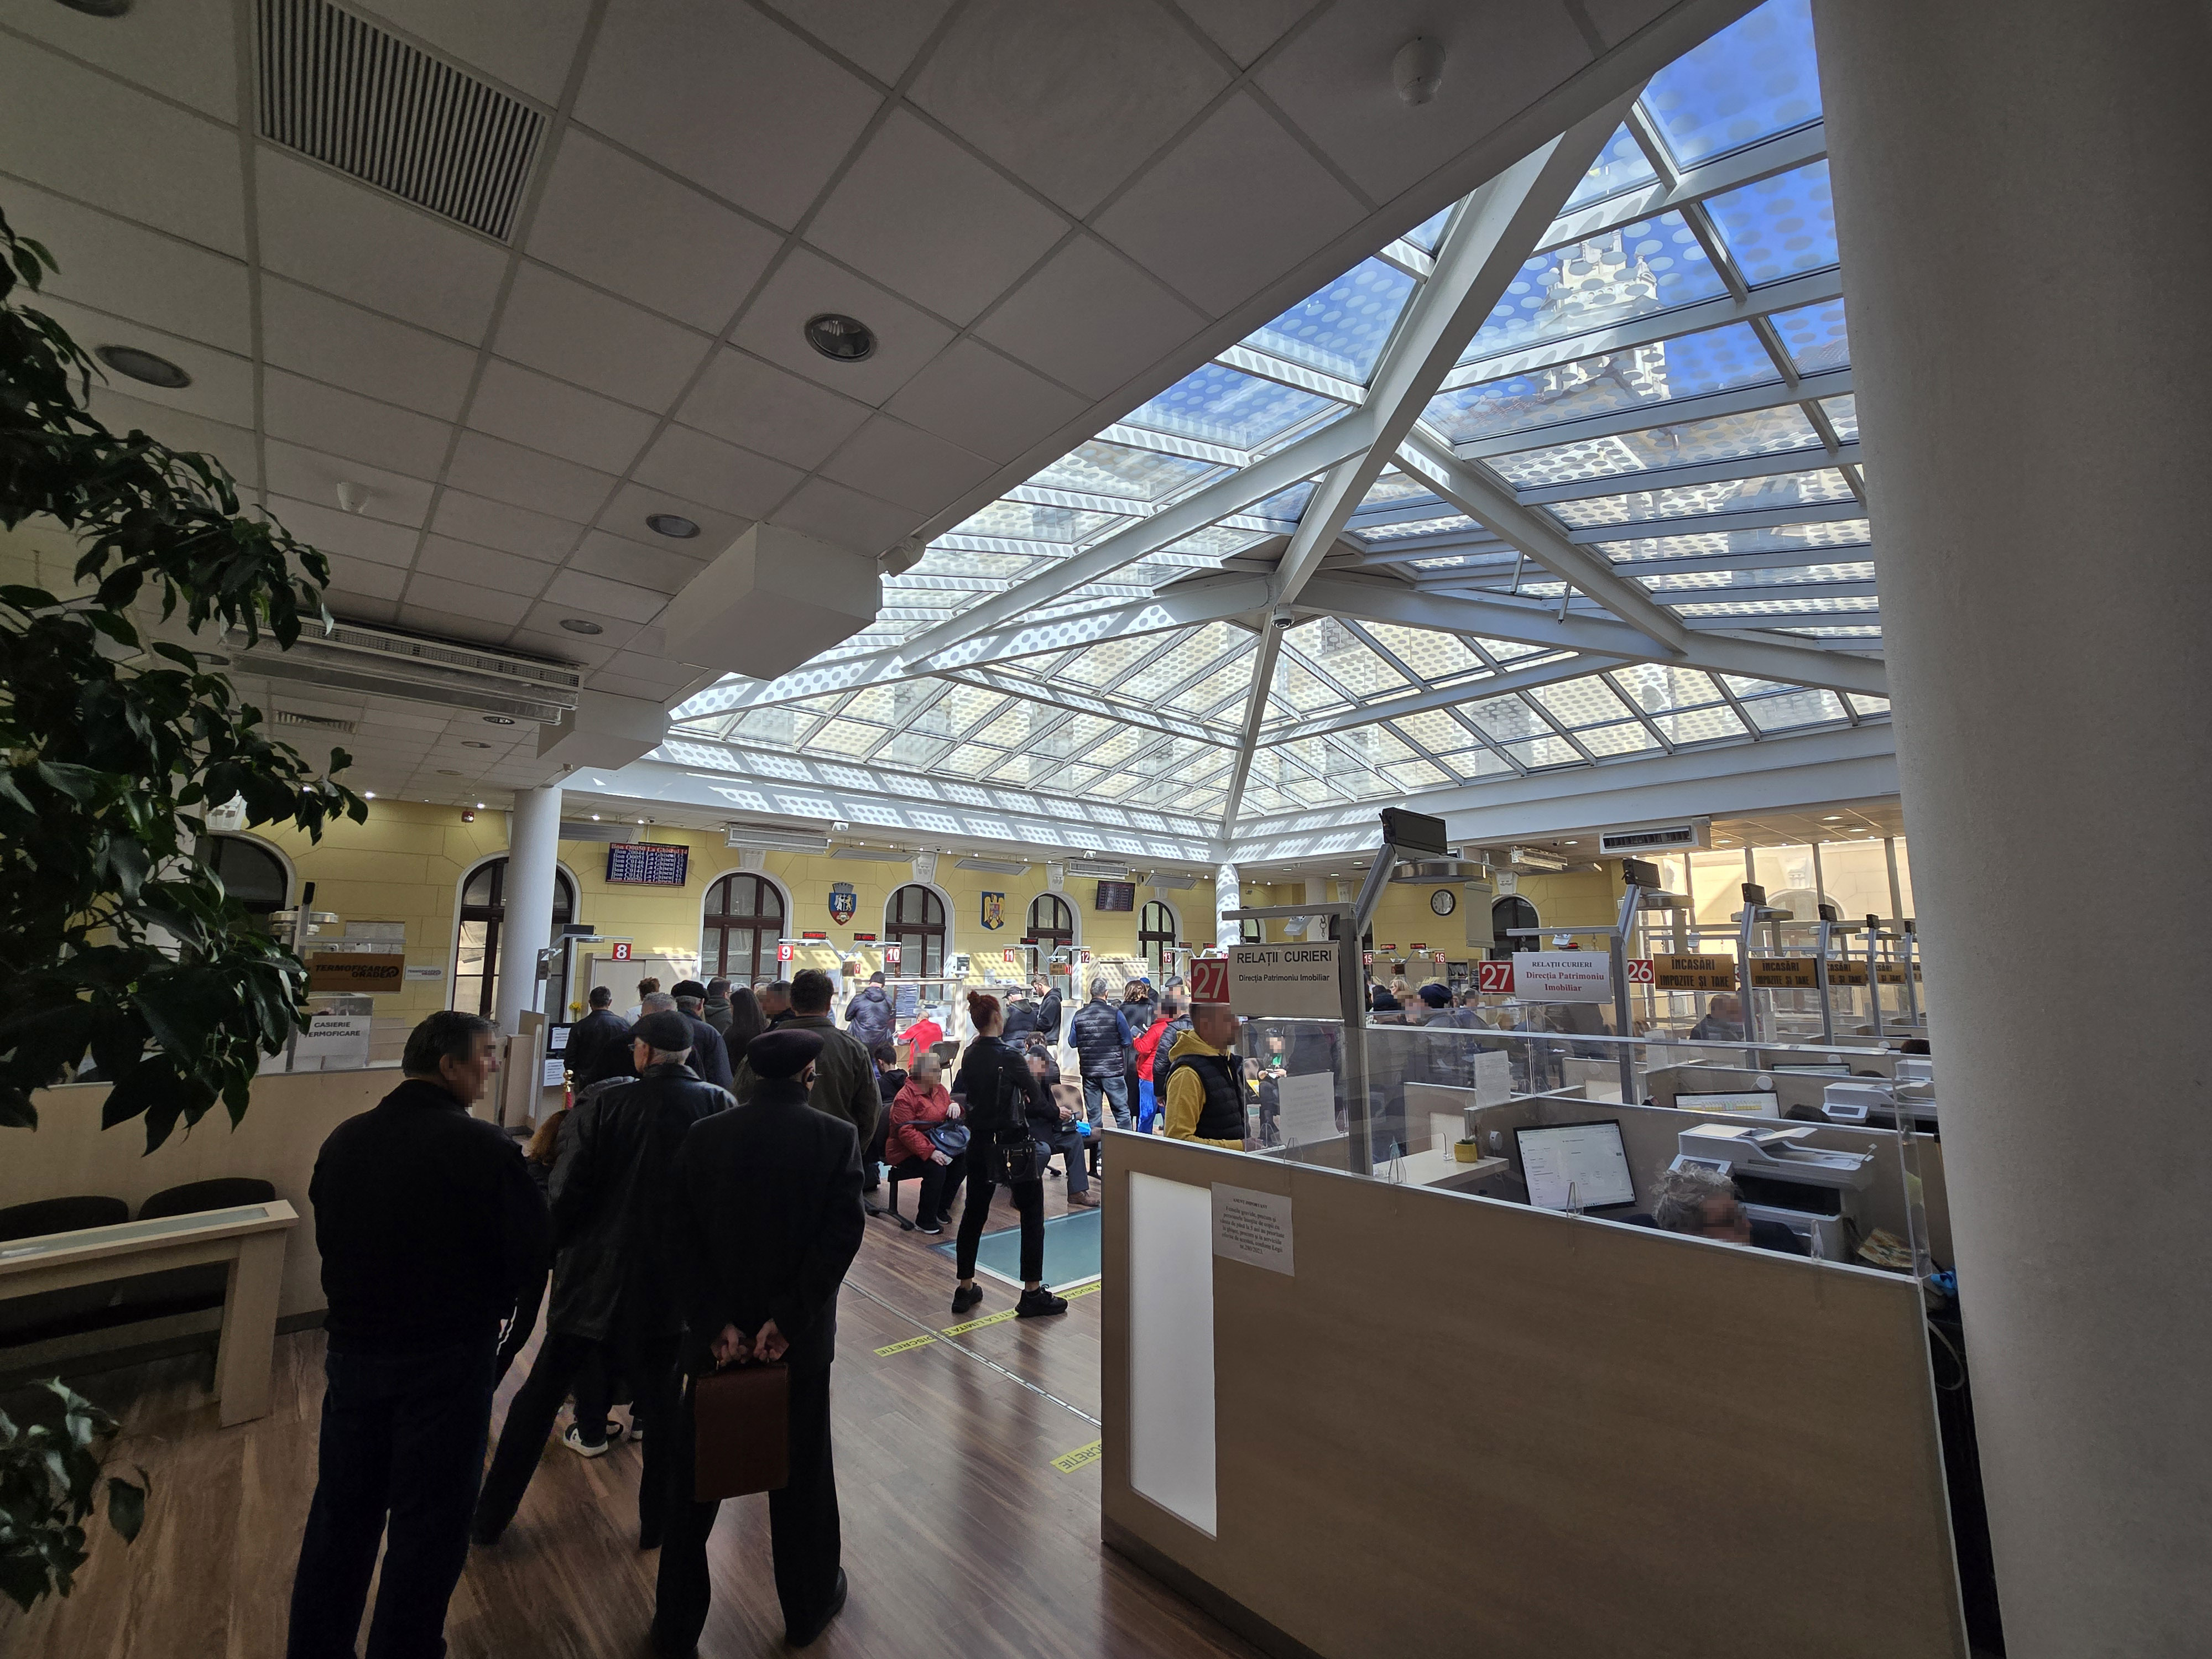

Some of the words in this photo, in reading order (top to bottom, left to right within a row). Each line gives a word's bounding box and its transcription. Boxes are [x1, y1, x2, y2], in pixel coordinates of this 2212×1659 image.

[617, 945, 627, 958] 8
[781, 946, 791, 959] 9
[888, 948, 900, 961] 10
[1005, 950, 1013, 961] 11
[1081, 952, 1089, 962] 12
[1164, 952, 1171, 962] 13
[1284, 950, 1332, 963] CURIERI
[1364, 954, 1372, 963] 15
[1436, 953, 1444, 962] 16
[315, 964, 387, 973] TERMOFICARE
[1628, 962, 1652, 982] 26
[1193, 963, 1225, 999] 27
[1481, 964, 1510, 990] 27
[1558, 972, 1604, 980] Patrimoniu
[1660, 975, 1694, 987] IMPOZITE
[1755, 975, 1782, 985] IMPOZITE
